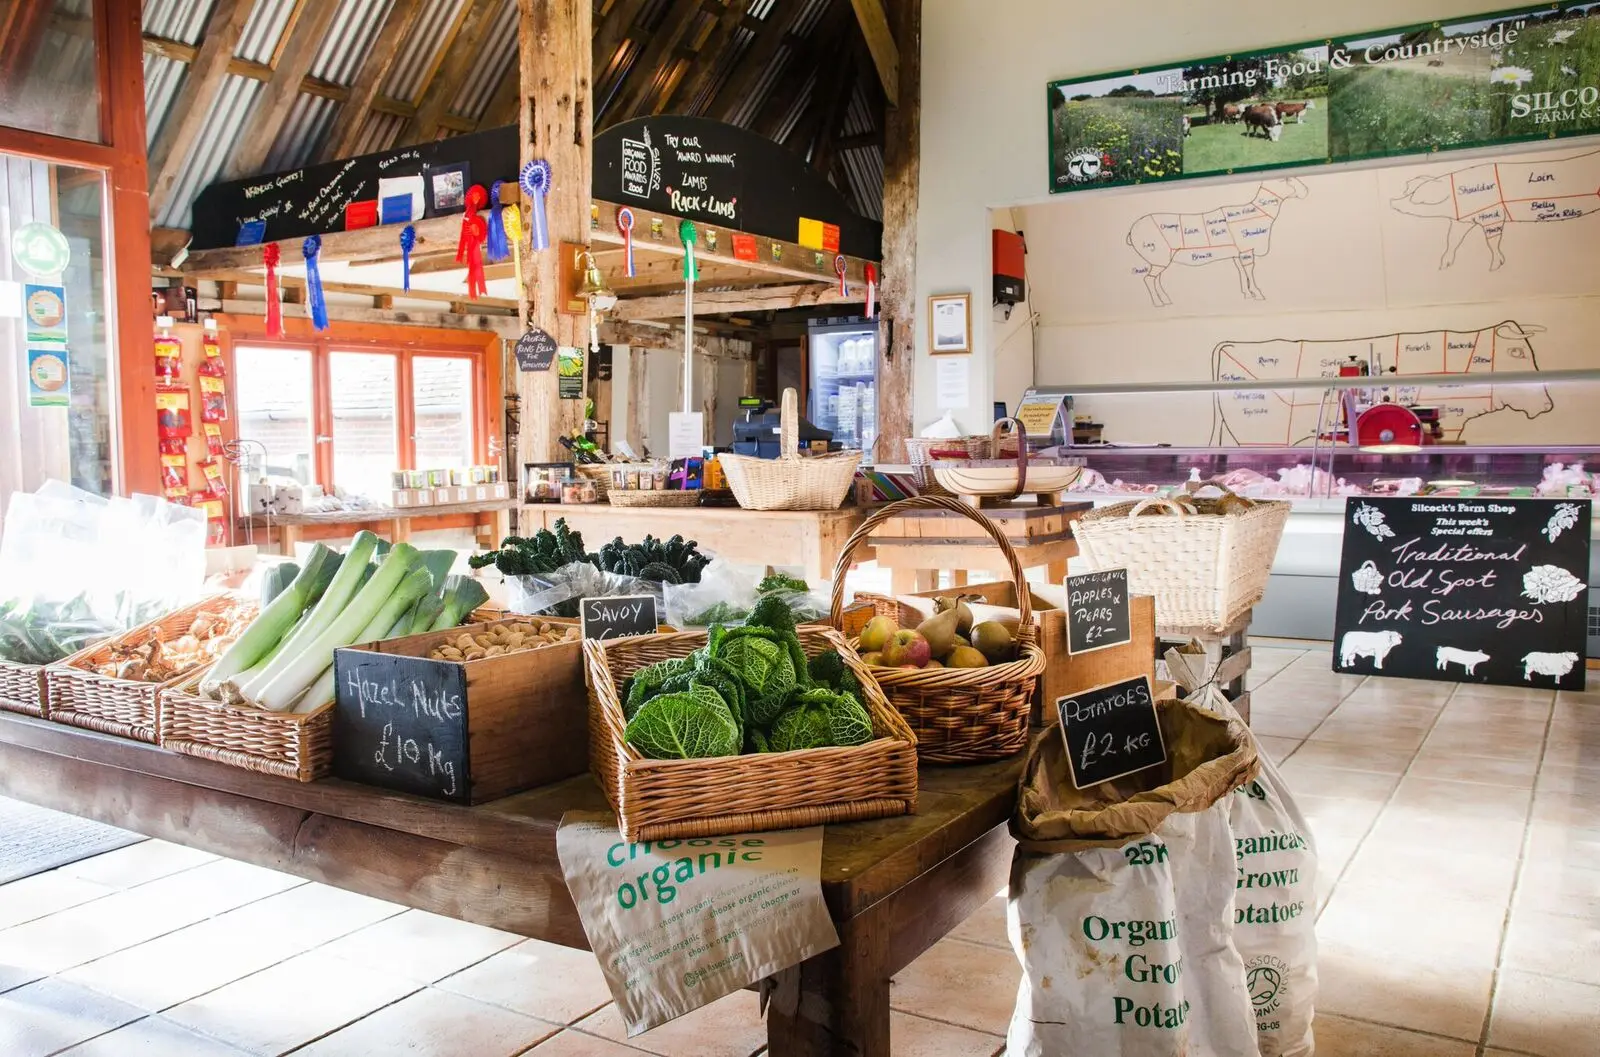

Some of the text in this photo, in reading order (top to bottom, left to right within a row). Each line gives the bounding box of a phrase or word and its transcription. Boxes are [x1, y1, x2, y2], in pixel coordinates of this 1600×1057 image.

[1264, 52, 1320, 80] Food
[1329, 48, 1355, 71] &
[1363, 20, 1526, 64] Countryside"
[1534, 108, 1576, 124] FARM
[1580, 108, 1592, 119] &
[664, 134, 701, 149] TRY OUR
[624, 148, 646, 160] ORGANIC
[624, 157, 647, 174] FOOD
[651, 147, 661, 191] SILVER
[624, 171, 647, 184] AWARDS
[1528, 172, 1555, 183] Loin
[628, 182, 643, 194] 2006
[1458, 183, 1496, 195] Shoulder
[671, 190, 700, 212] RACK
[708, 195, 736, 219] LAMB
[1531, 202, 1555, 212] Belly
[1537, 209, 1583, 221] Spare Ribs
[1241, 227, 1268, 238] Shoulder
[1143, 241, 1155, 252] Leg
[517, 342, 554, 354] RING BELL
[1259, 356, 1279, 368] Rump
[1411, 503, 1516, 514] Silcock's Farm Shop
[1436, 518, 1489, 526] This week's
[1431, 527, 1493, 536] Special offers
[1392, 537, 1527, 564] Traditional
[1388, 568, 1497, 596] Old Spot
[1069, 587, 1112, 606] APPLES
[588, 601, 642, 623] SAVOY
[1359, 599, 1544, 629] Pork Sausages
[1060, 685, 1150, 727] POTATOES
[374, 722, 421, 771] £10
[1081, 731, 1117, 771] £2
[617, 848, 764, 909] organic
[686, 896, 715, 914] organic
[710, 901, 736, 919] choose
[738, 886, 770, 904] organic
[673, 933, 700, 951] organic
[761, 892, 789, 910] choose
[791, 887, 801, 897] or
[689, 941, 714, 958] choose
[716, 927, 743, 944] organic
